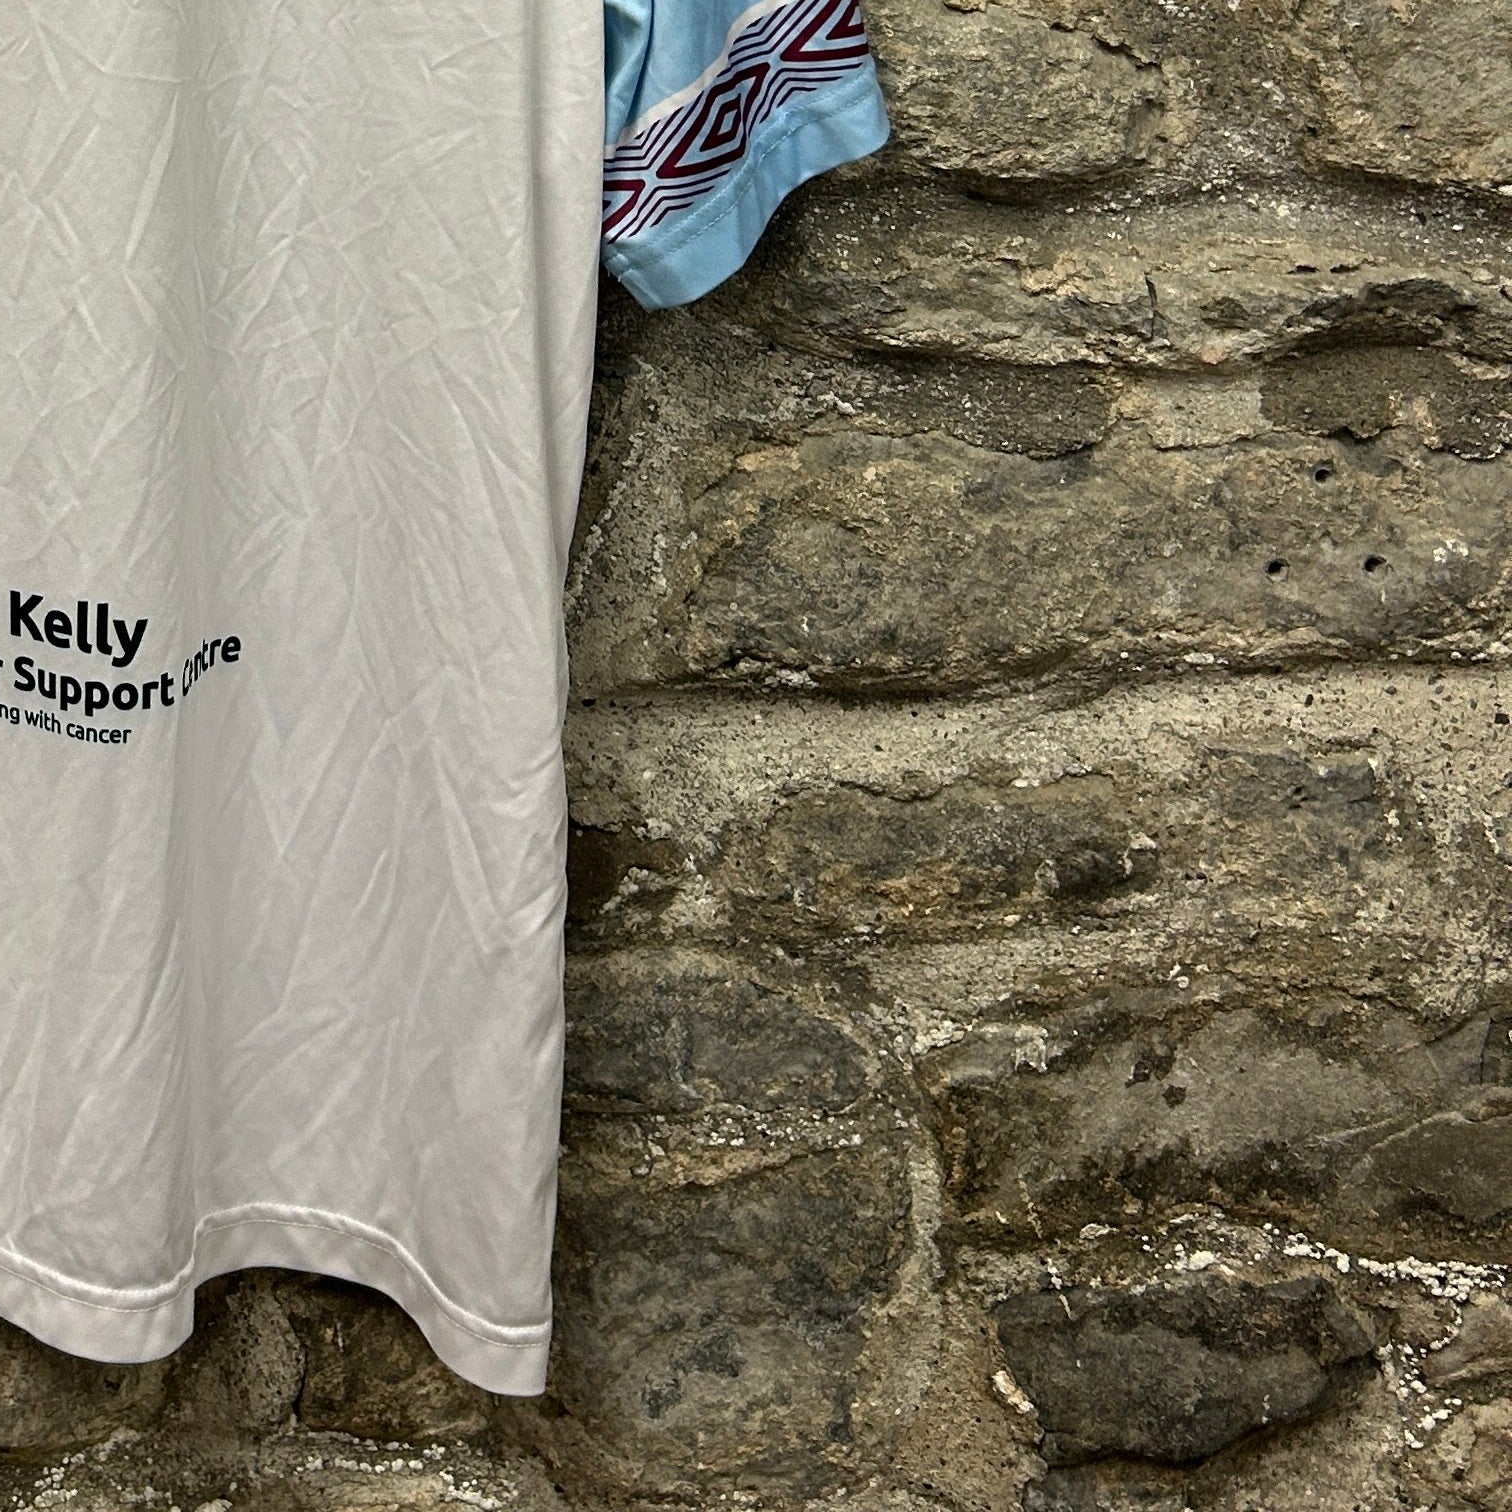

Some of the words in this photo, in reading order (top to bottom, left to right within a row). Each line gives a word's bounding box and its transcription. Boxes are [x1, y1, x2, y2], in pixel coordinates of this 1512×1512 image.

[9, 590, 149, 668] Kelly
[13, 656, 175, 718] Support
[24, 705, 62, 735] with
[66, 722, 132, 744] cancer
